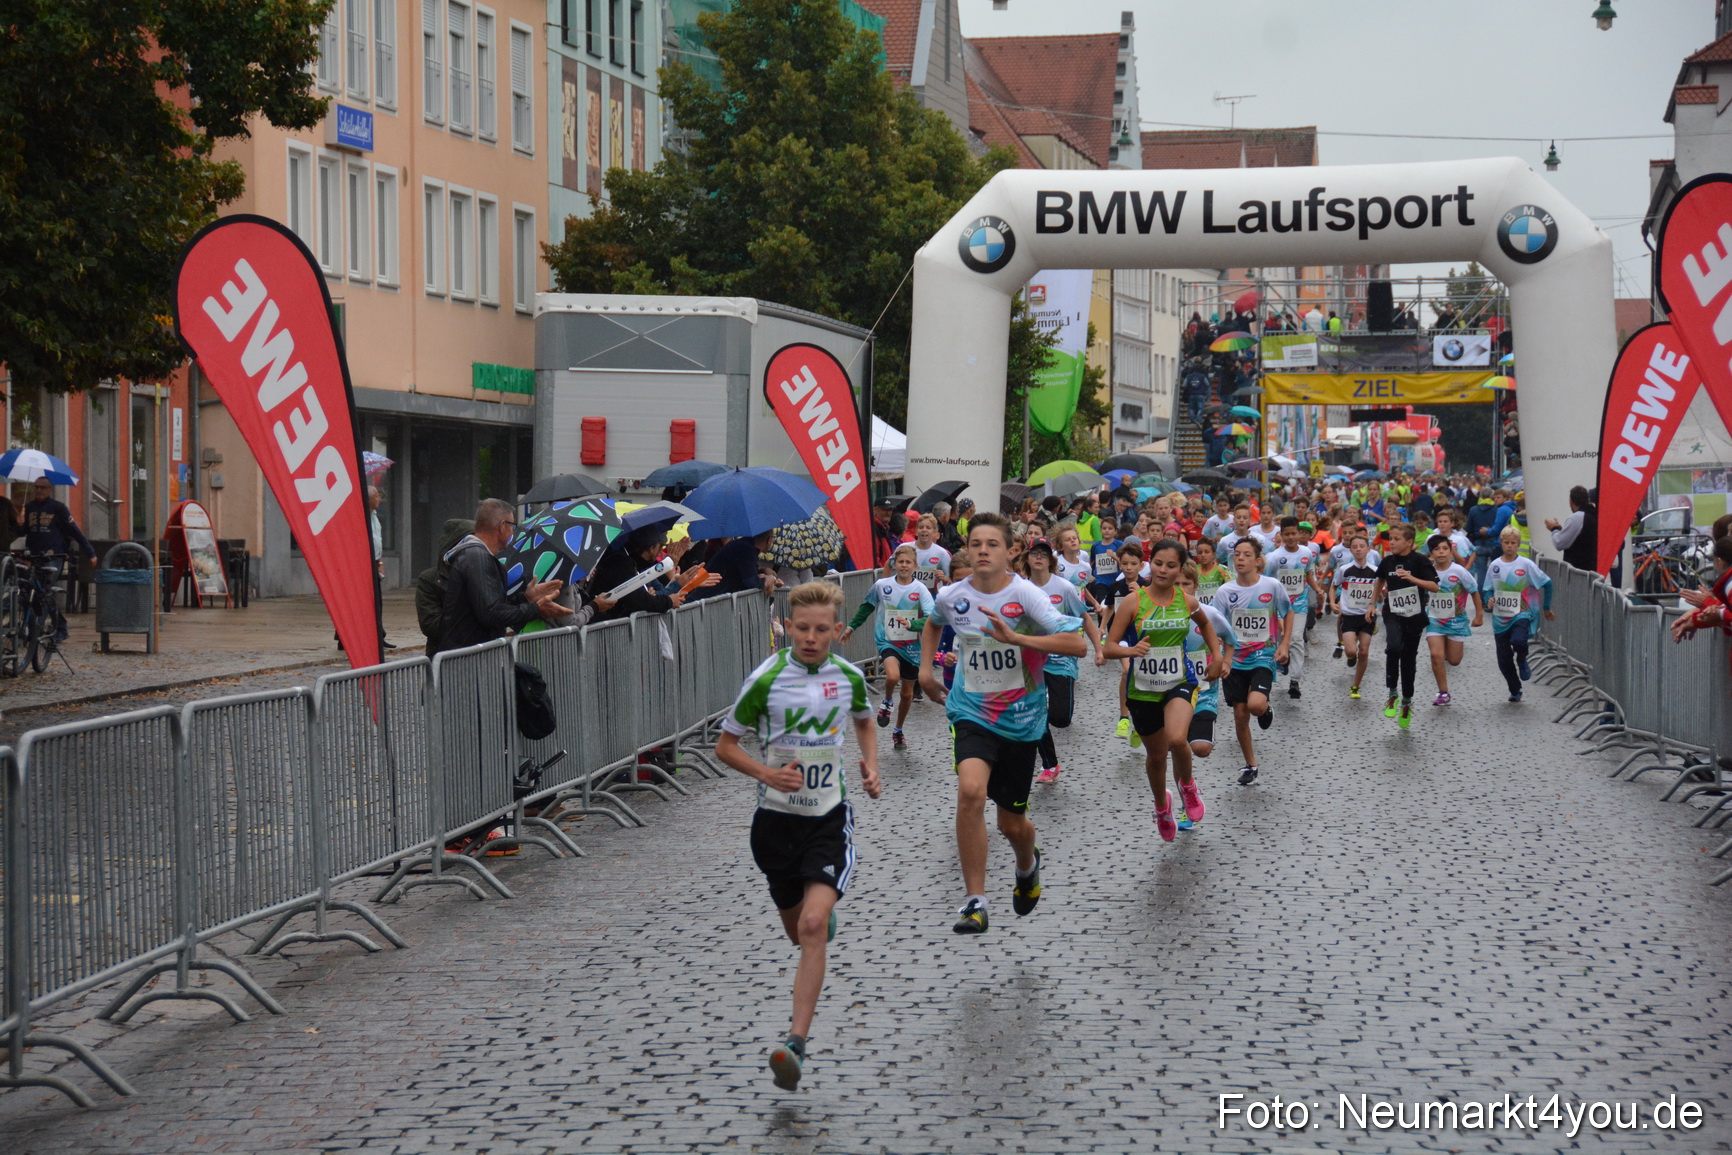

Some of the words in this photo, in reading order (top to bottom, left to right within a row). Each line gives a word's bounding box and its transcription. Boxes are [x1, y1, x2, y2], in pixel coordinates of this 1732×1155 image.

[1036, 190, 1187, 234] BMW
[1203, 185, 1475, 240] Laufsport
[1504, 206, 1554, 226] BMW
[963, 217, 1010, 238] BMW
[1353, 380, 1404, 397] ZIEL
[1609, 342, 1689, 484] REWE
[910, 456, 990, 467] www.bmw-laufsport.de
[1312, 465, 1321, 474] A
[1097, 557, 1116, 567] 4009
[911, 571, 934, 580] 4024
[1280, 574, 1303, 585] 4034
[1350, 589, 1373, 599] 4042
[1392, 593, 1418, 608] 4043
[1430, 599, 1453, 609] 4109
[1496, 597, 1518, 608] 4003
[888, 617, 915, 628] 41
[1142, 618, 1187, 630] BOCK
[1235, 616, 1266, 630] 4052
[969, 648, 1017, 671] 4108
[1138, 657, 1178, 675] 4040
[1012, 701, 1028, 712] 17.
[781, 737, 797, 746] KW
[788, 794, 819, 807] Niklas
